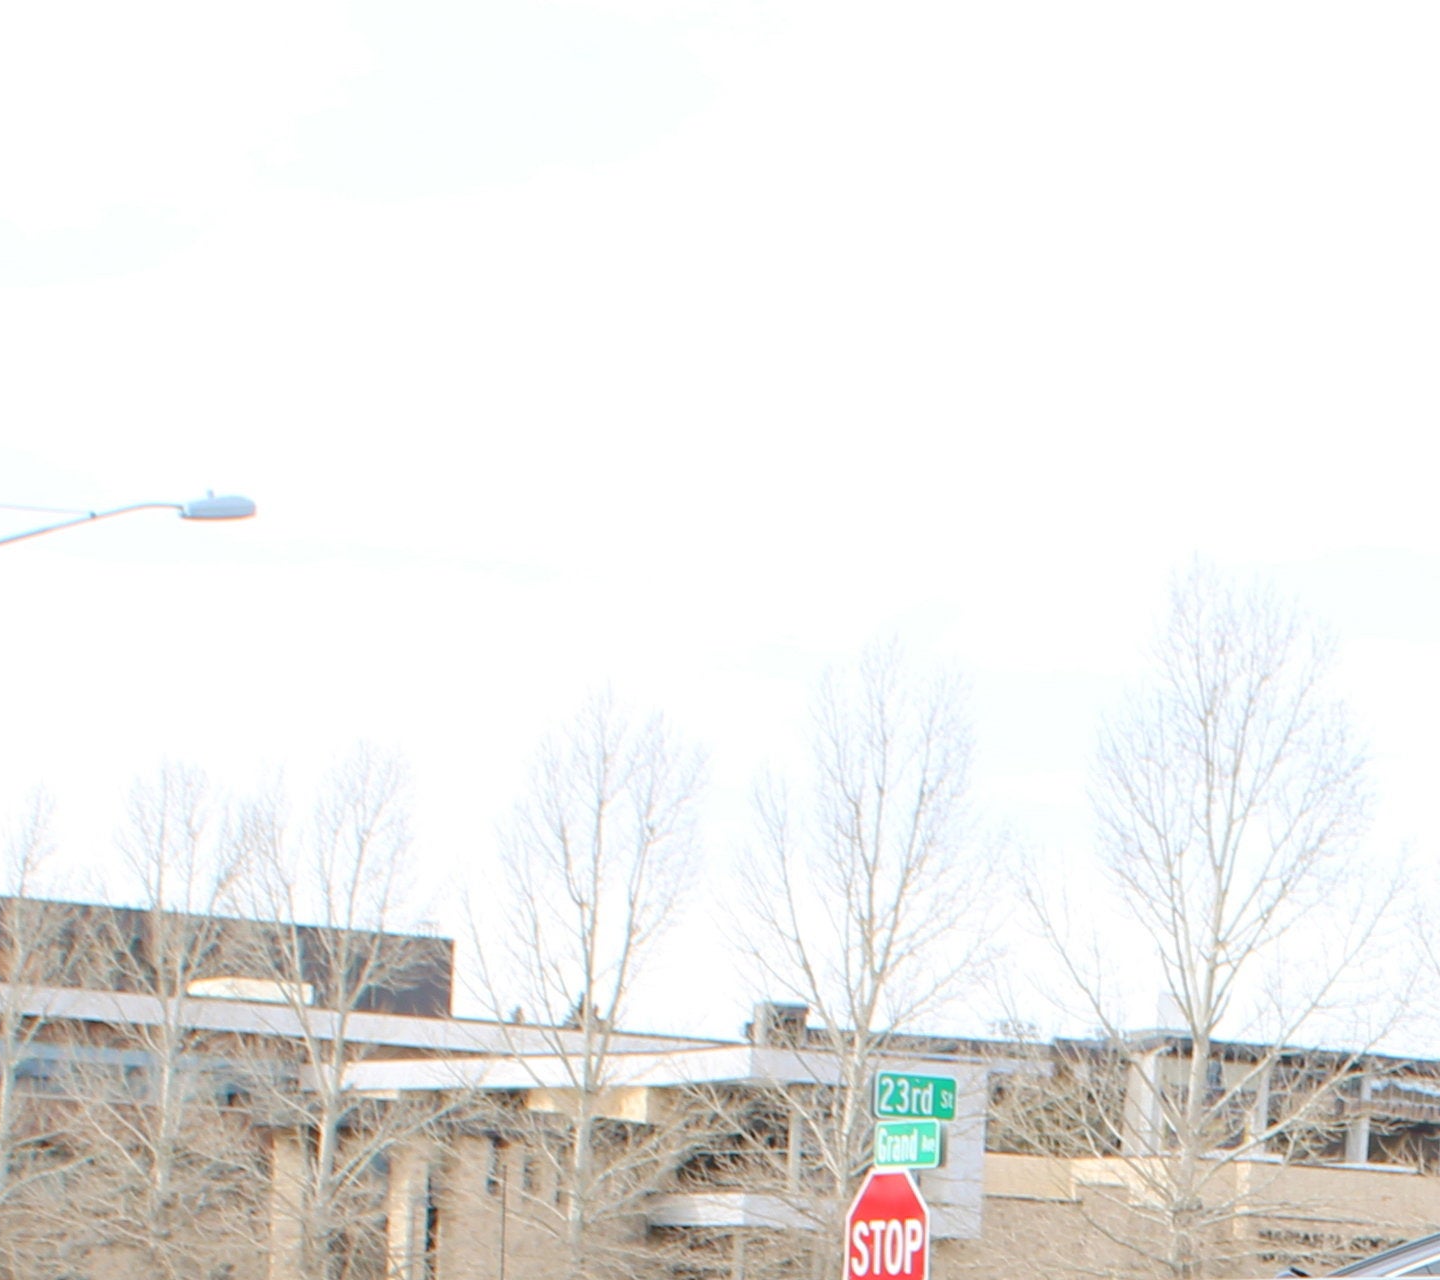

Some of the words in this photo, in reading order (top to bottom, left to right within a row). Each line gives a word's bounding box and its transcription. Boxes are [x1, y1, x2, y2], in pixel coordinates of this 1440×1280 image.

[879, 1077, 934, 1115] 23rd
[877, 1128, 918, 1162] Grand
[850, 1218, 923, 1277] STOP
